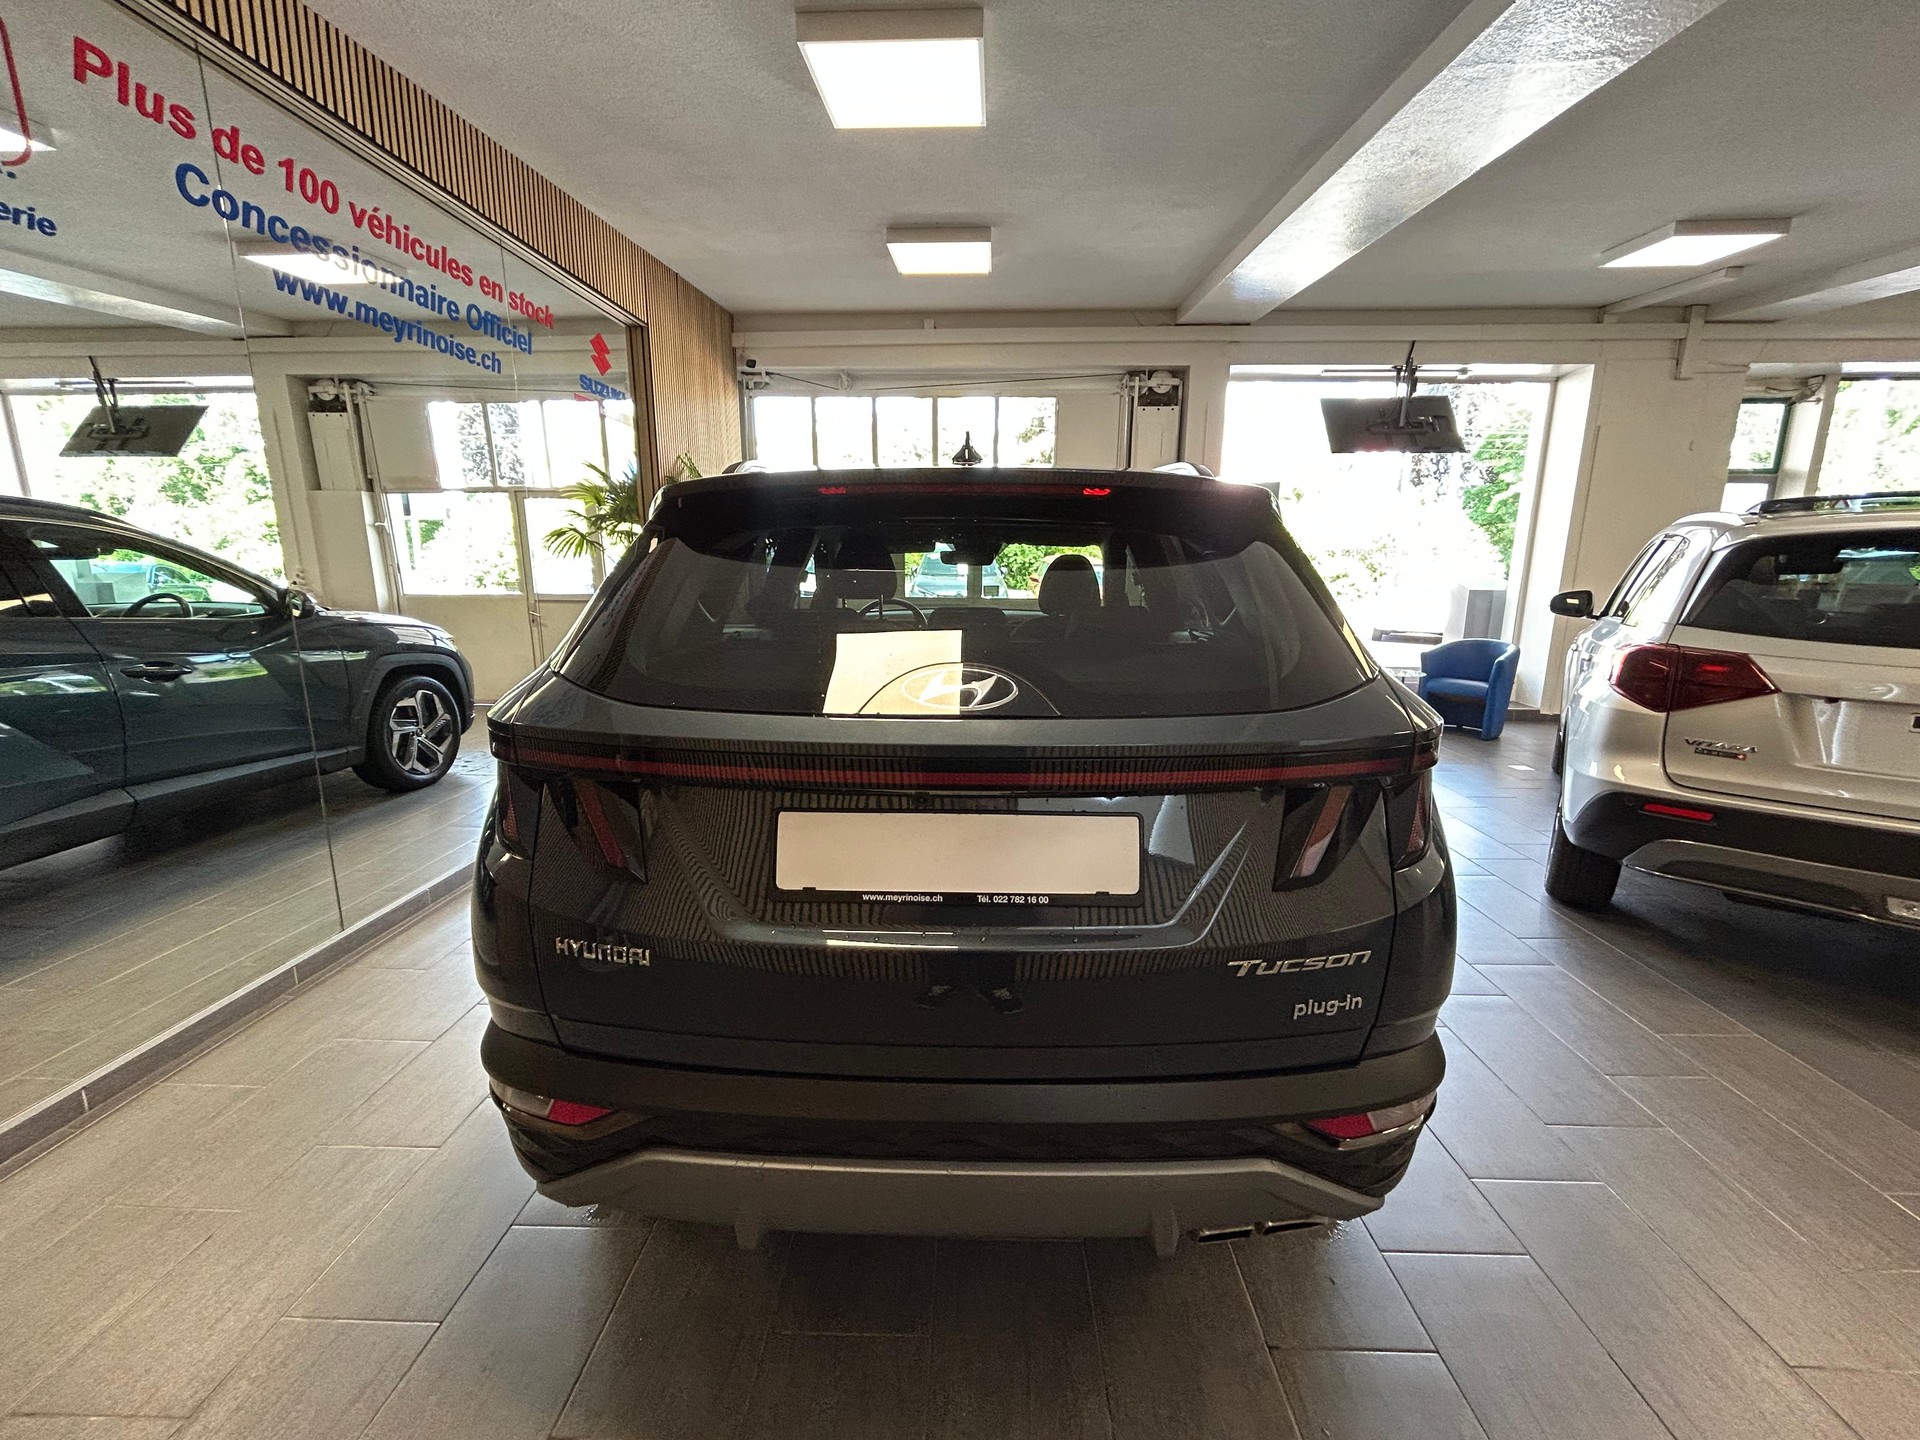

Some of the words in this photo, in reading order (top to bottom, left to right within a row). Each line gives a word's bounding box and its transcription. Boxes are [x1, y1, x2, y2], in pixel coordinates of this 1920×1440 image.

[73, 35, 196, 139] Plus
[211, 125, 265, 176] de
[278, 157, 340, 215] 100
[349, 200, 474, 287] véhicules
[479, 275, 503, 302] en
[508, 291, 554, 329] stock
[175, 162, 460, 322] Concessionnaire
[466, 303, 533, 355] Officiel
[272, 267, 502, 374] www.meyrinoise.ch
[862, 893, 943, 903] www.meyrinoise.ch
[976, 894, 991, 904] Tél.
[993, 894, 1009, 904] 022
[1010, 895, 1025, 904] 782
[1027, 895, 1037, 904] 16
[1038, 895, 1049, 904] 00
[555, 937, 650, 966] HYUNDAI
[1292, 994, 1363, 1020] plug-in
